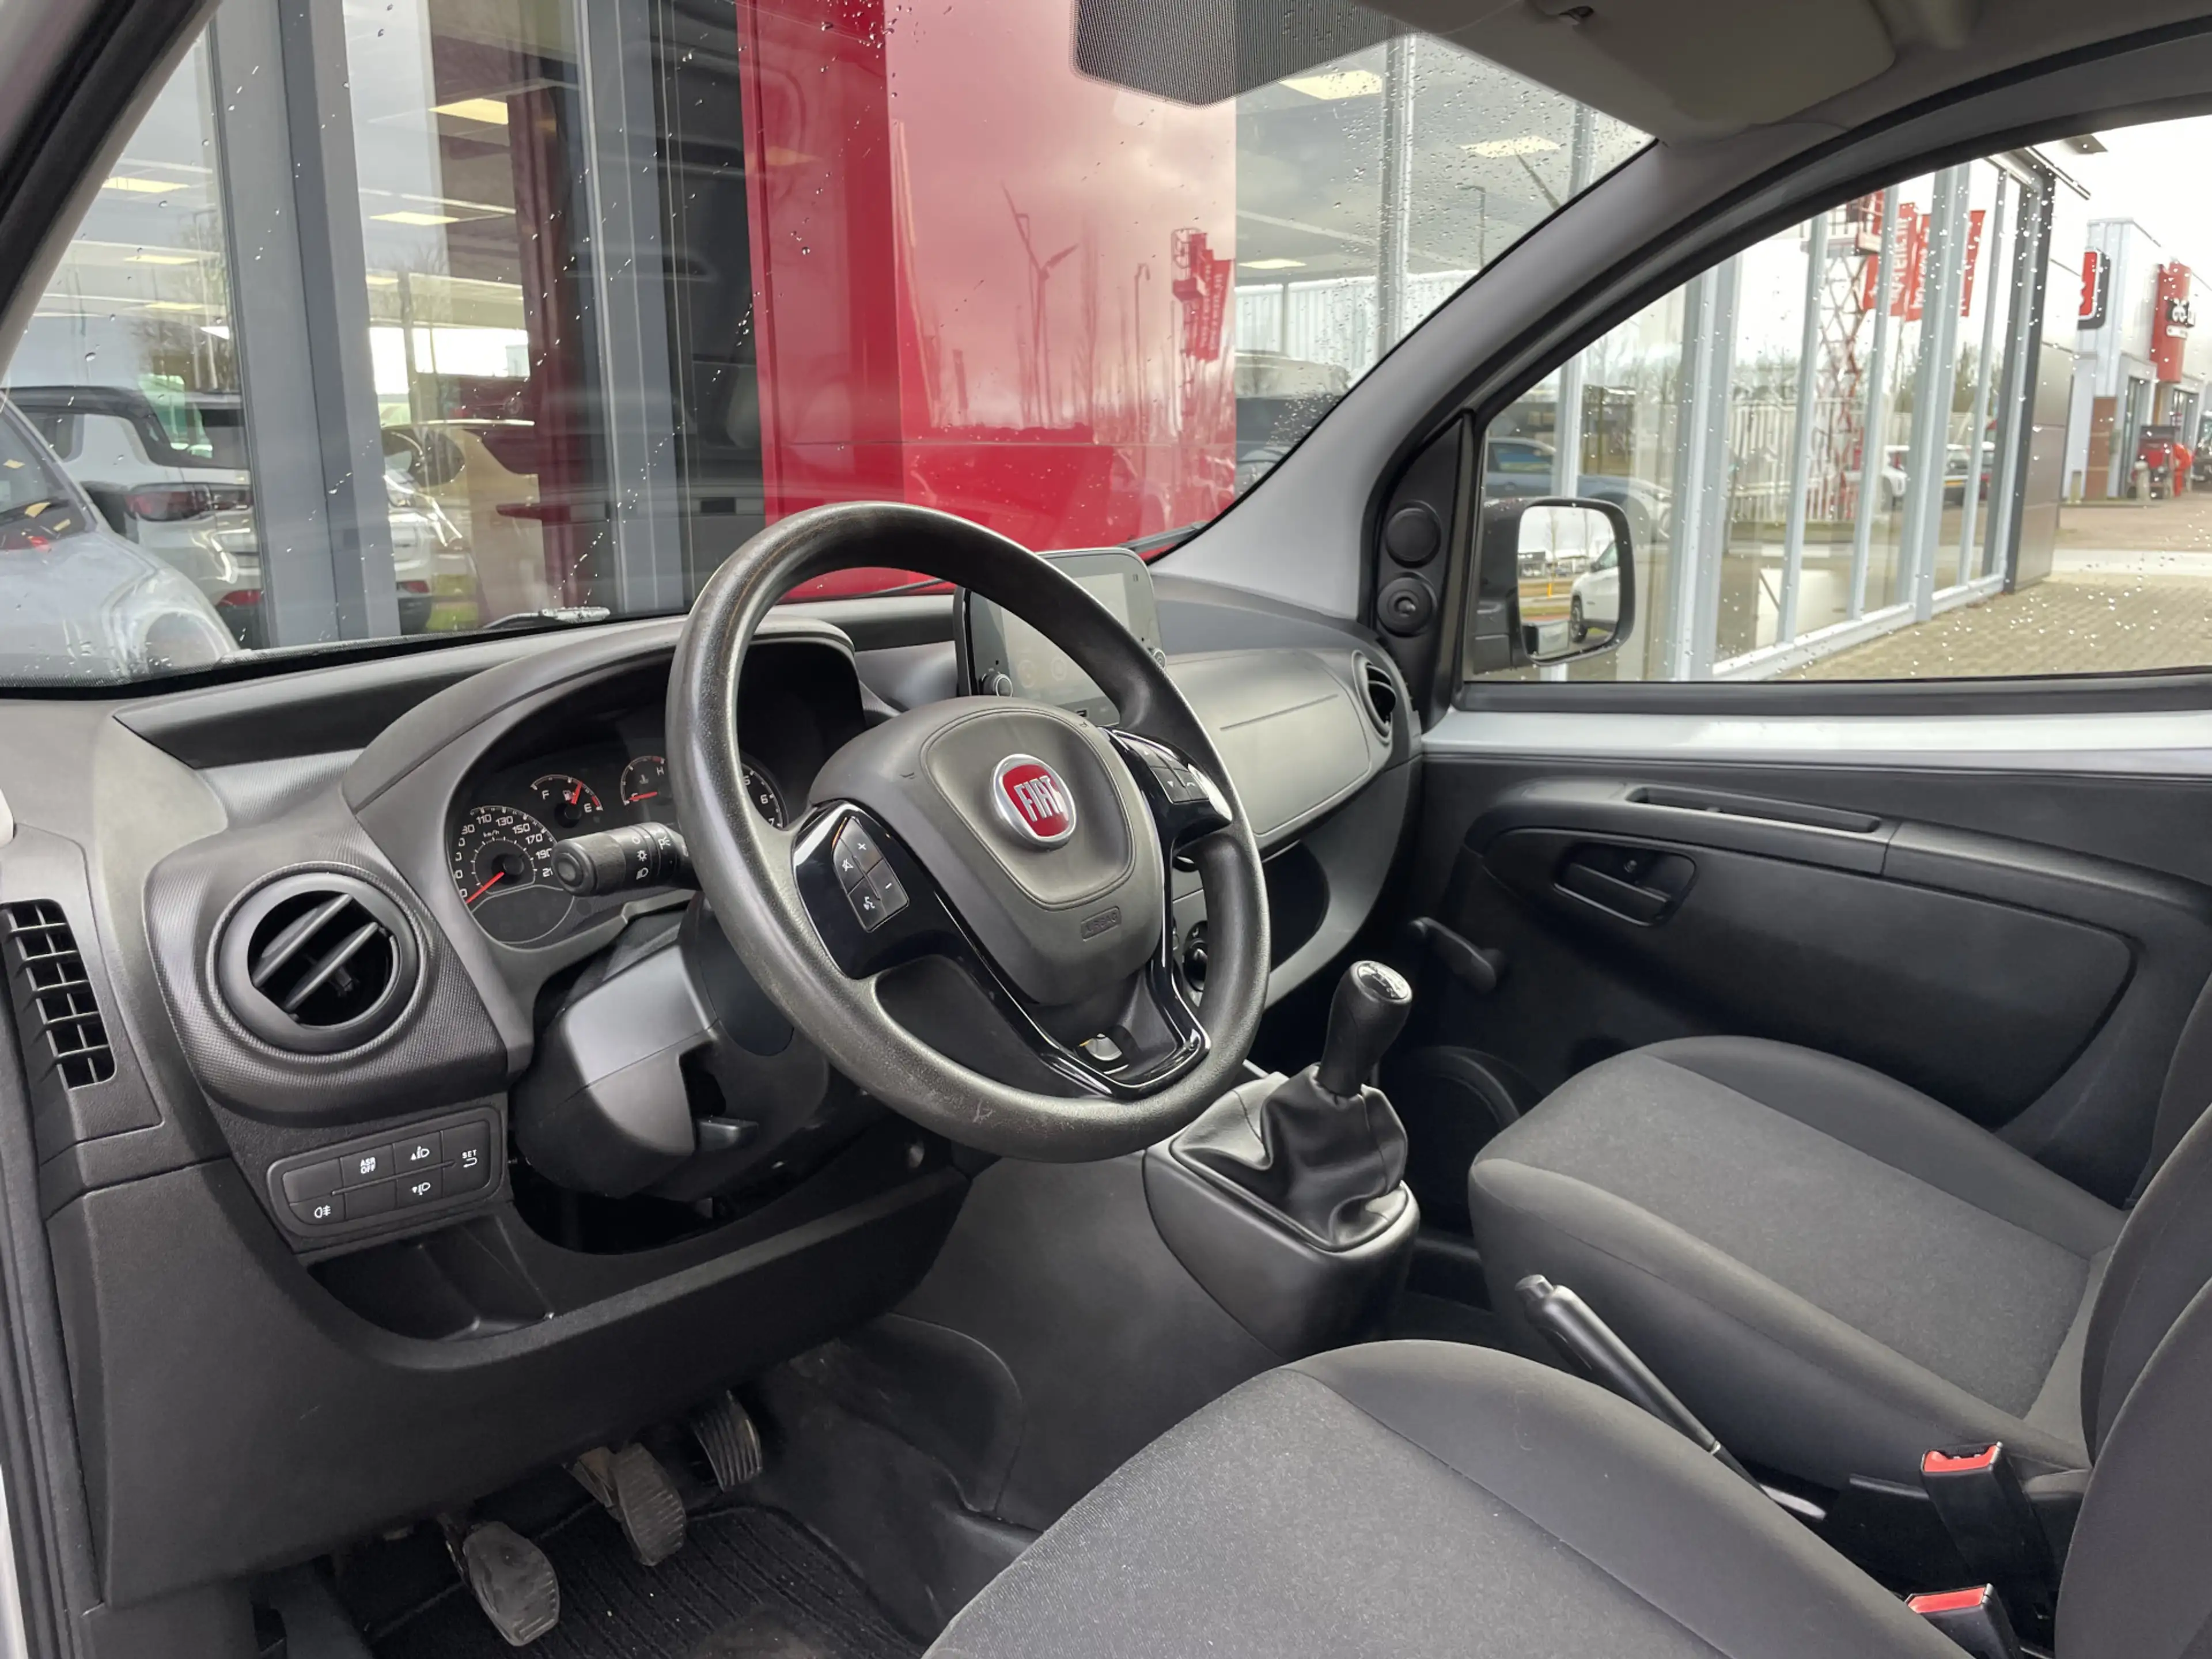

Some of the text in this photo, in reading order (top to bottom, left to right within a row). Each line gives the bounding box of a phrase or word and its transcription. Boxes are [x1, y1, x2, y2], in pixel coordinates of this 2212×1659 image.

[656, 767, 665, 777] H
[541, 790, 550, 800] F
[760, 794, 768, 804] 6
[1013, 775, 1063, 822] FIAT
[584, 803, 592, 813] E
[476, 814, 492, 825] 110
[495, 816, 514, 827] 130
[768, 817, 775, 826] 7
[512, 823, 531, 834] 150
[483, 830, 500, 838] km/h
[525, 834, 543, 844] 170
[462, 1150, 477, 1159] SET
[360, 1157, 376, 1167] ASR
[360, 1164, 376, 1174] OFF
